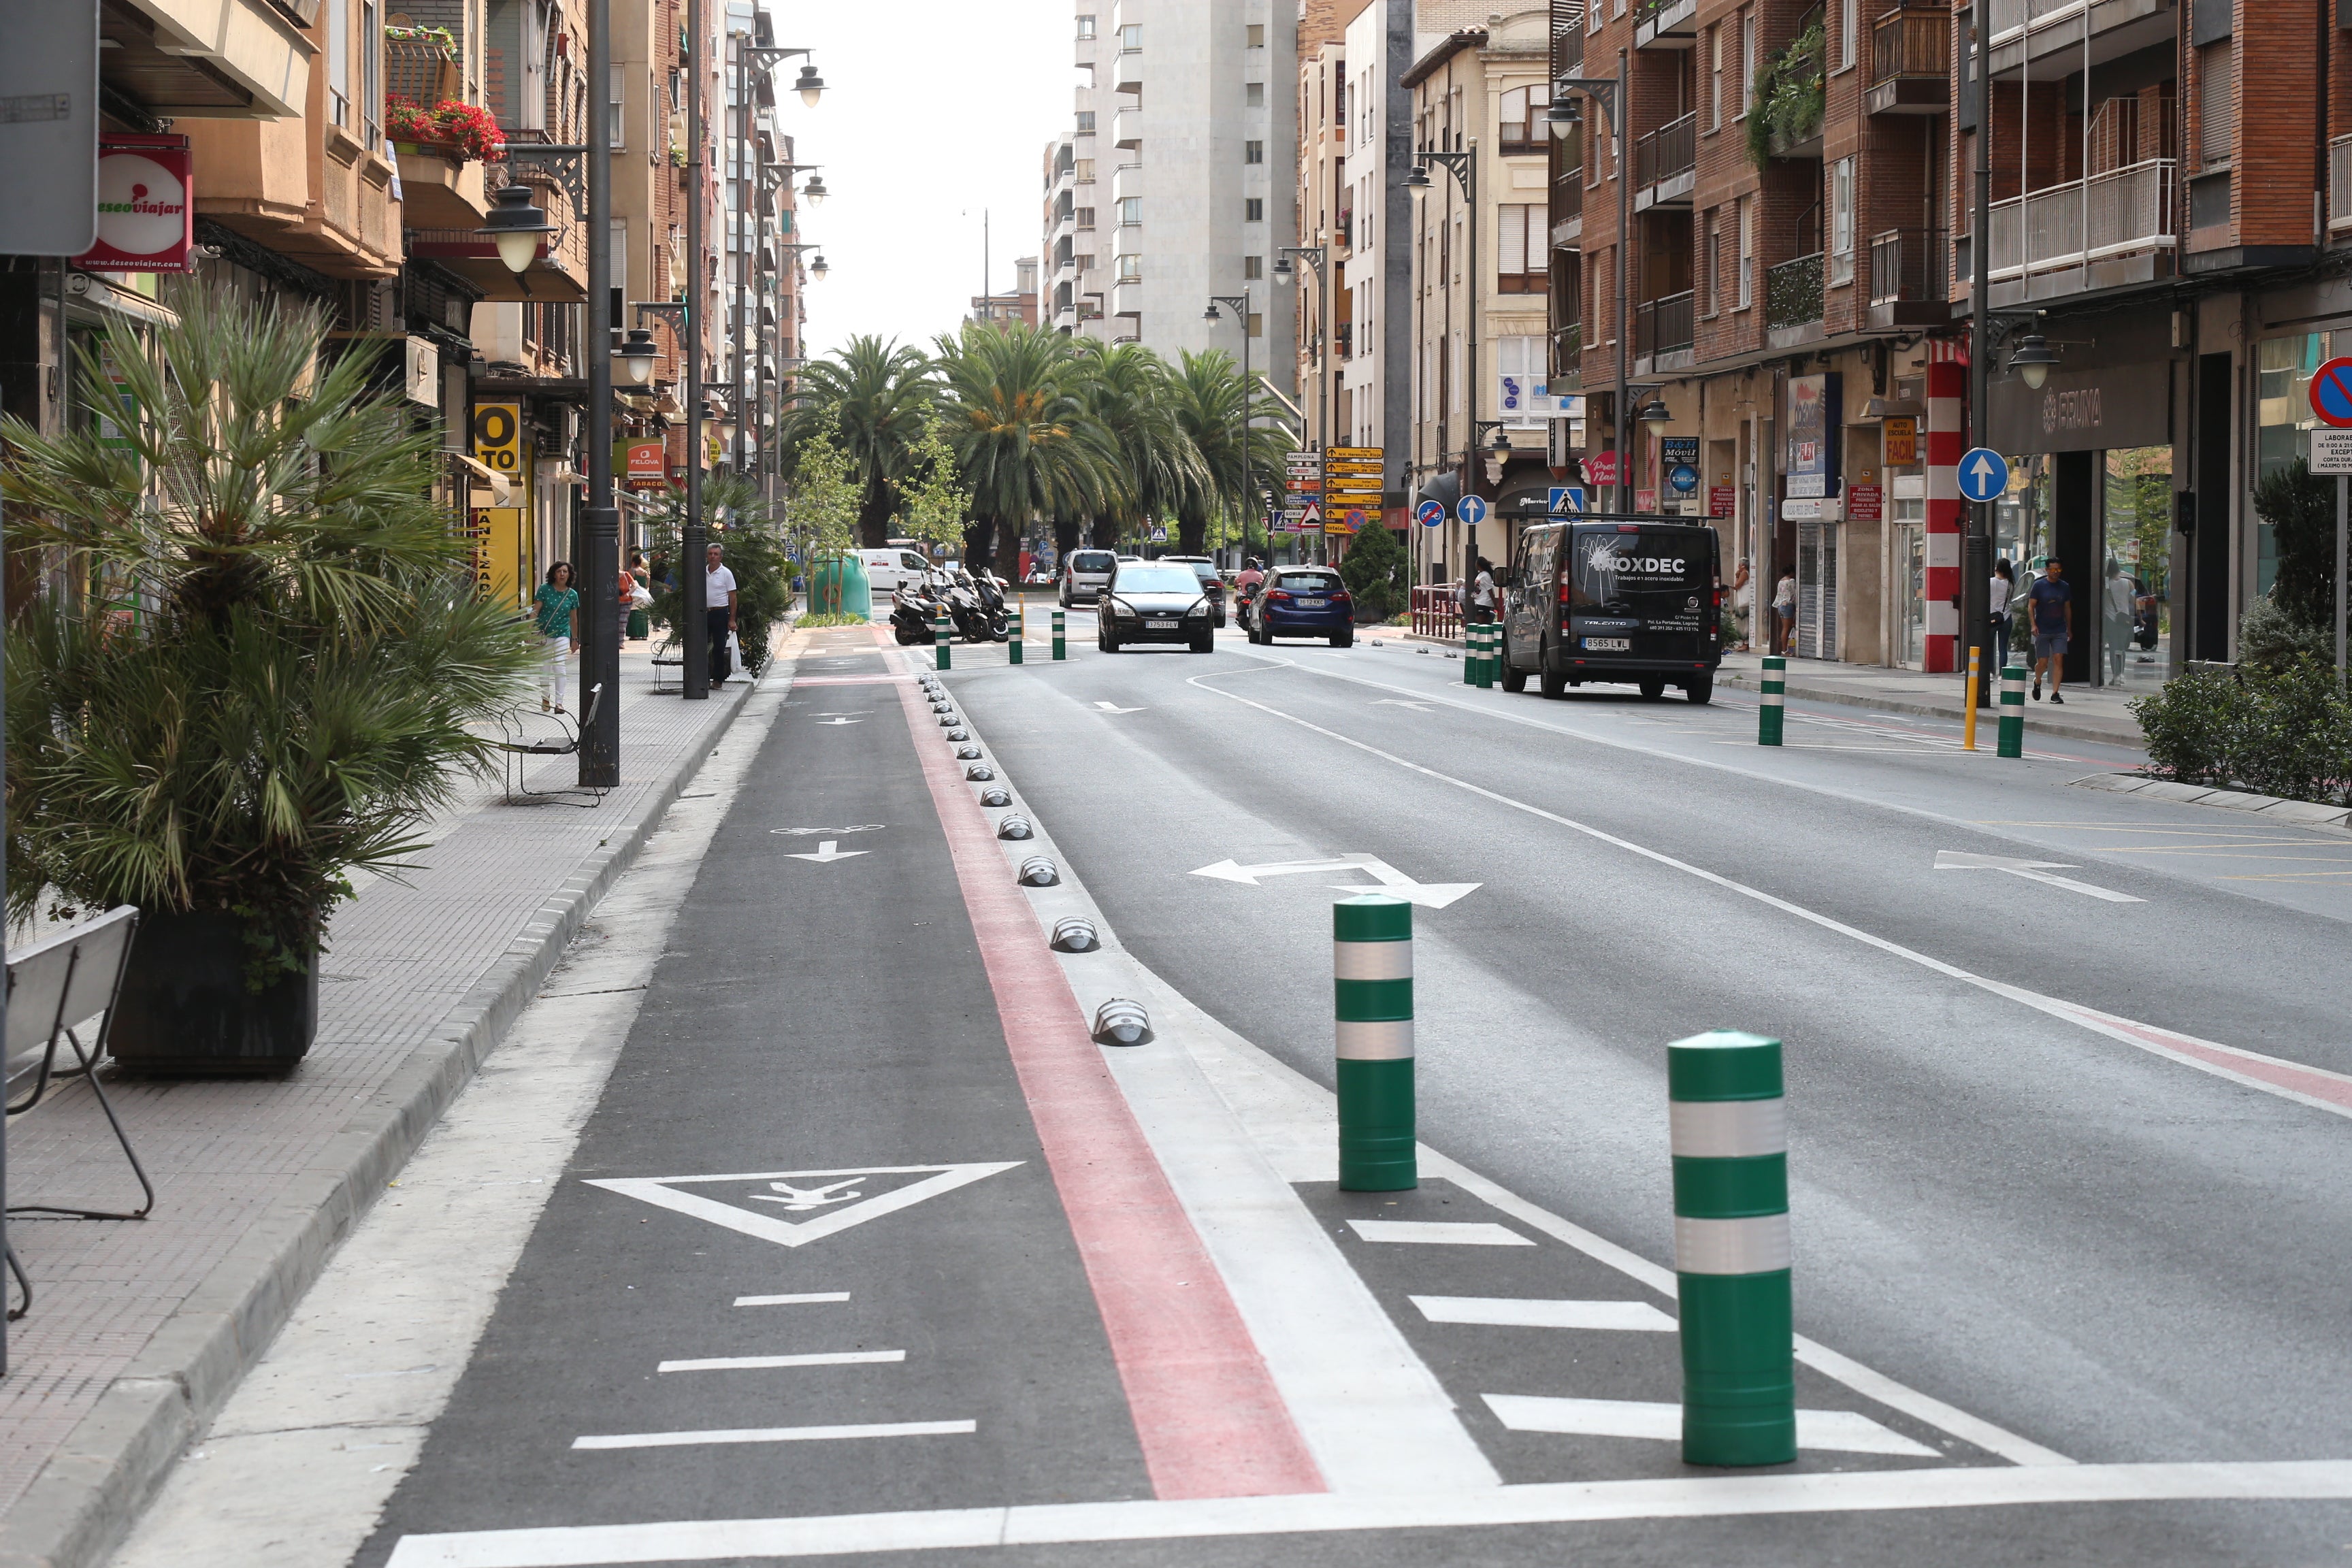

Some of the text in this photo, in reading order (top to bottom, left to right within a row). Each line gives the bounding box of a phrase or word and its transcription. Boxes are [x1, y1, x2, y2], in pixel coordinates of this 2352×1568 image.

[98, 201, 183, 216] eseoviajar
[85, 259, 181, 267] www.deseoviajar.com
[1886, 440, 1914, 461] FACIL
[1593, 461, 1629, 471] Prety
[478, 508, 491, 602] ANTIZADO
[1588, 639, 1627, 648] 8565 LWL
